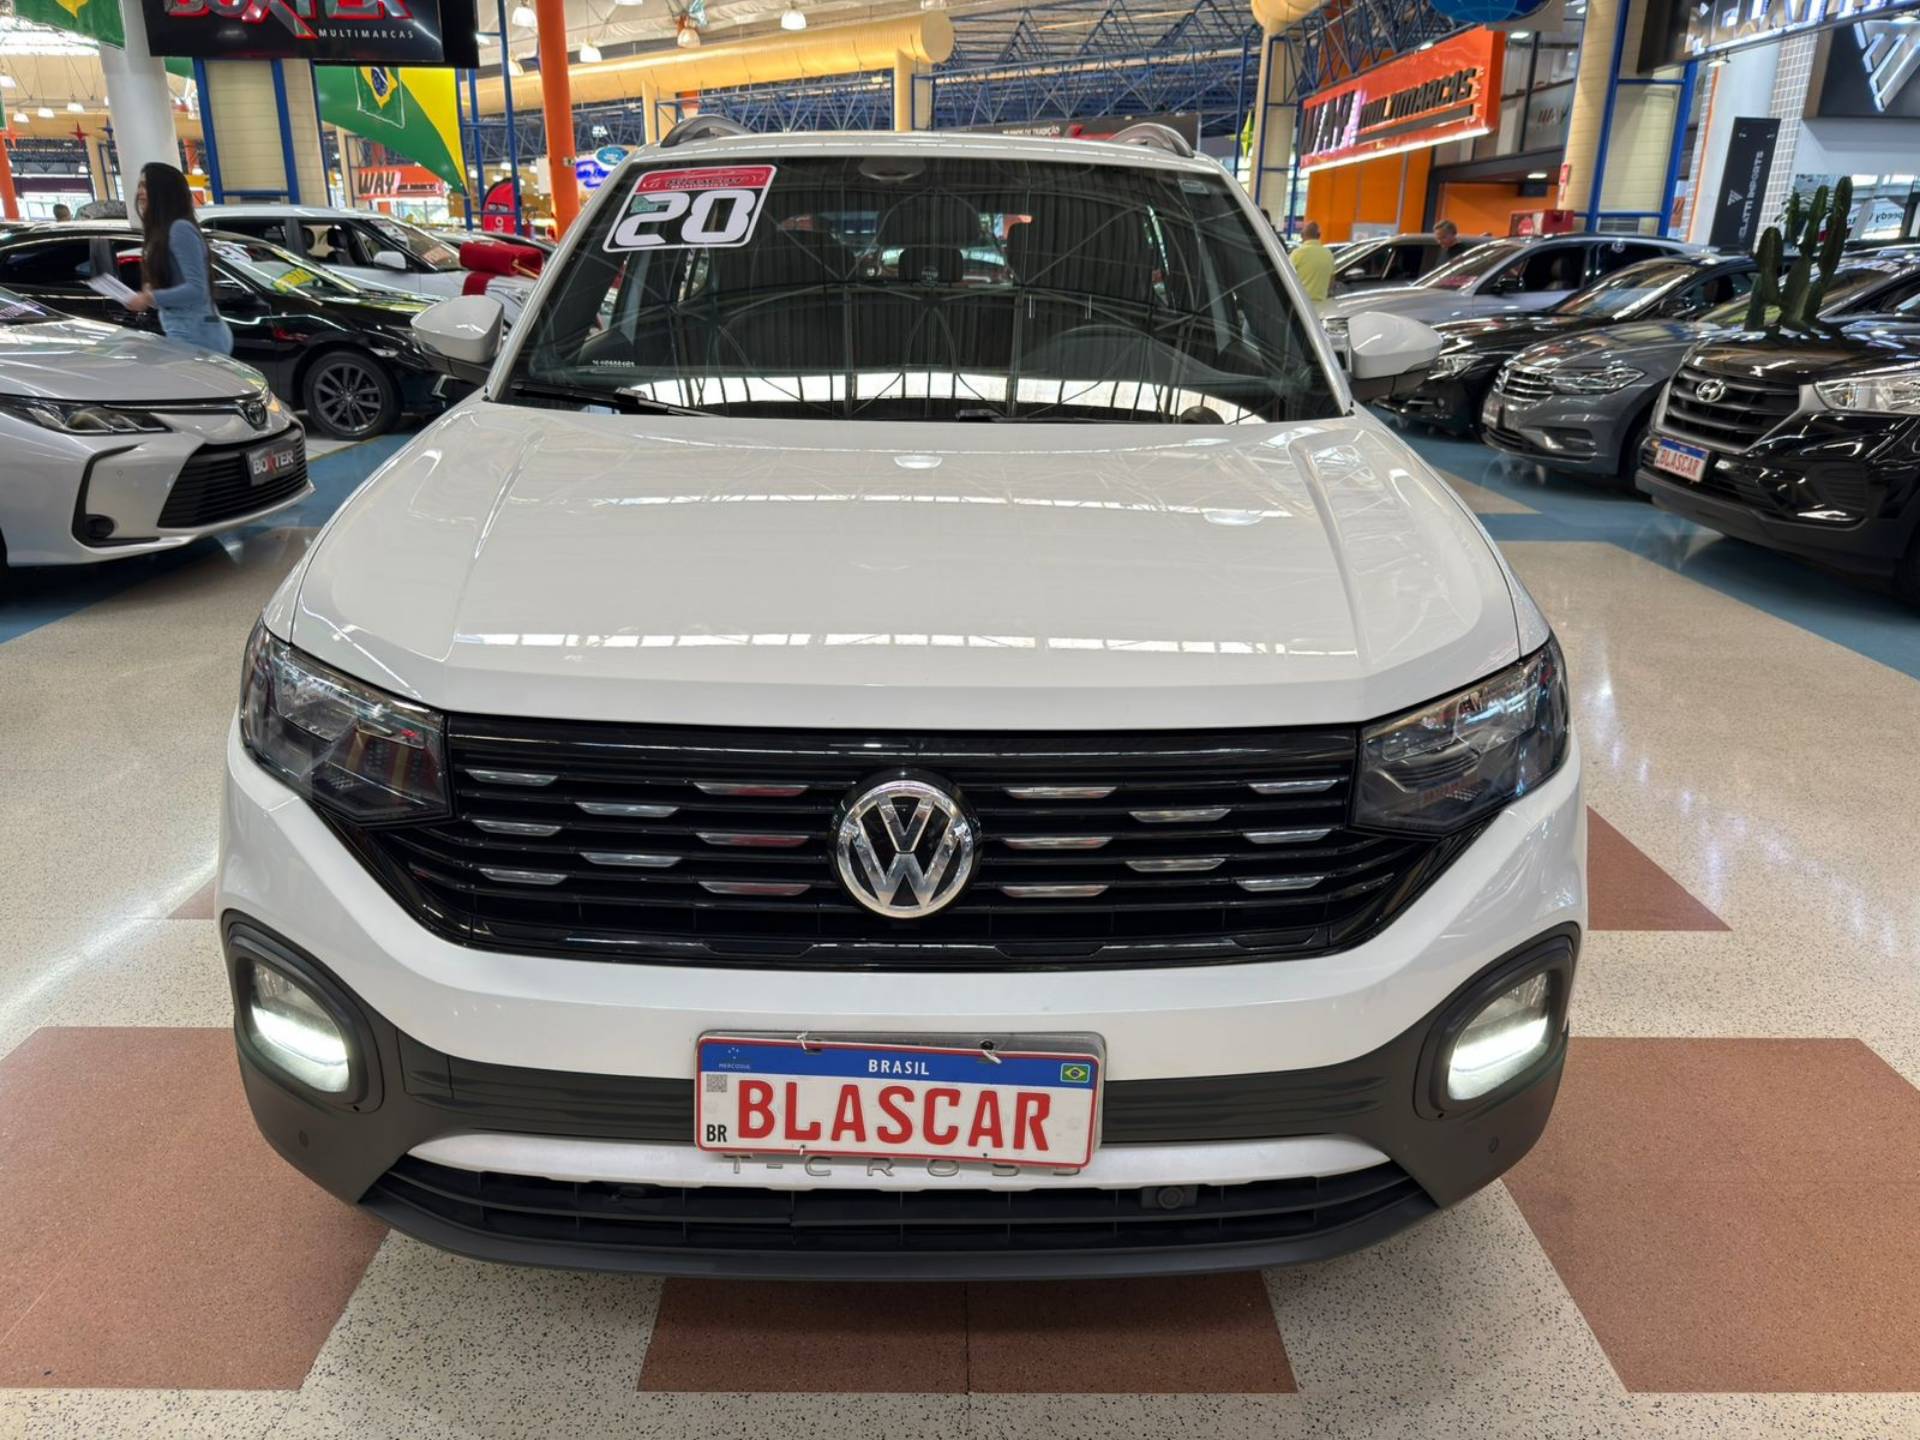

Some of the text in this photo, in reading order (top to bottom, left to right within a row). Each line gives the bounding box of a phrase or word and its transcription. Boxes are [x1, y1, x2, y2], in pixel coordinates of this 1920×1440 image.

[319, 29, 414, 39] MULTIMARCAS
[1302, 68, 1477, 155] WAY MULTIMARCAS
[359, 172, 397, 194] WAY
[1659, 449, 1700, 475] BLASCAR
[868, 1058, 930, 1075] BRASIL
[737, 1079, 1051, 1152] BLASCAR
[706, 1124, 728, 1142] BR
